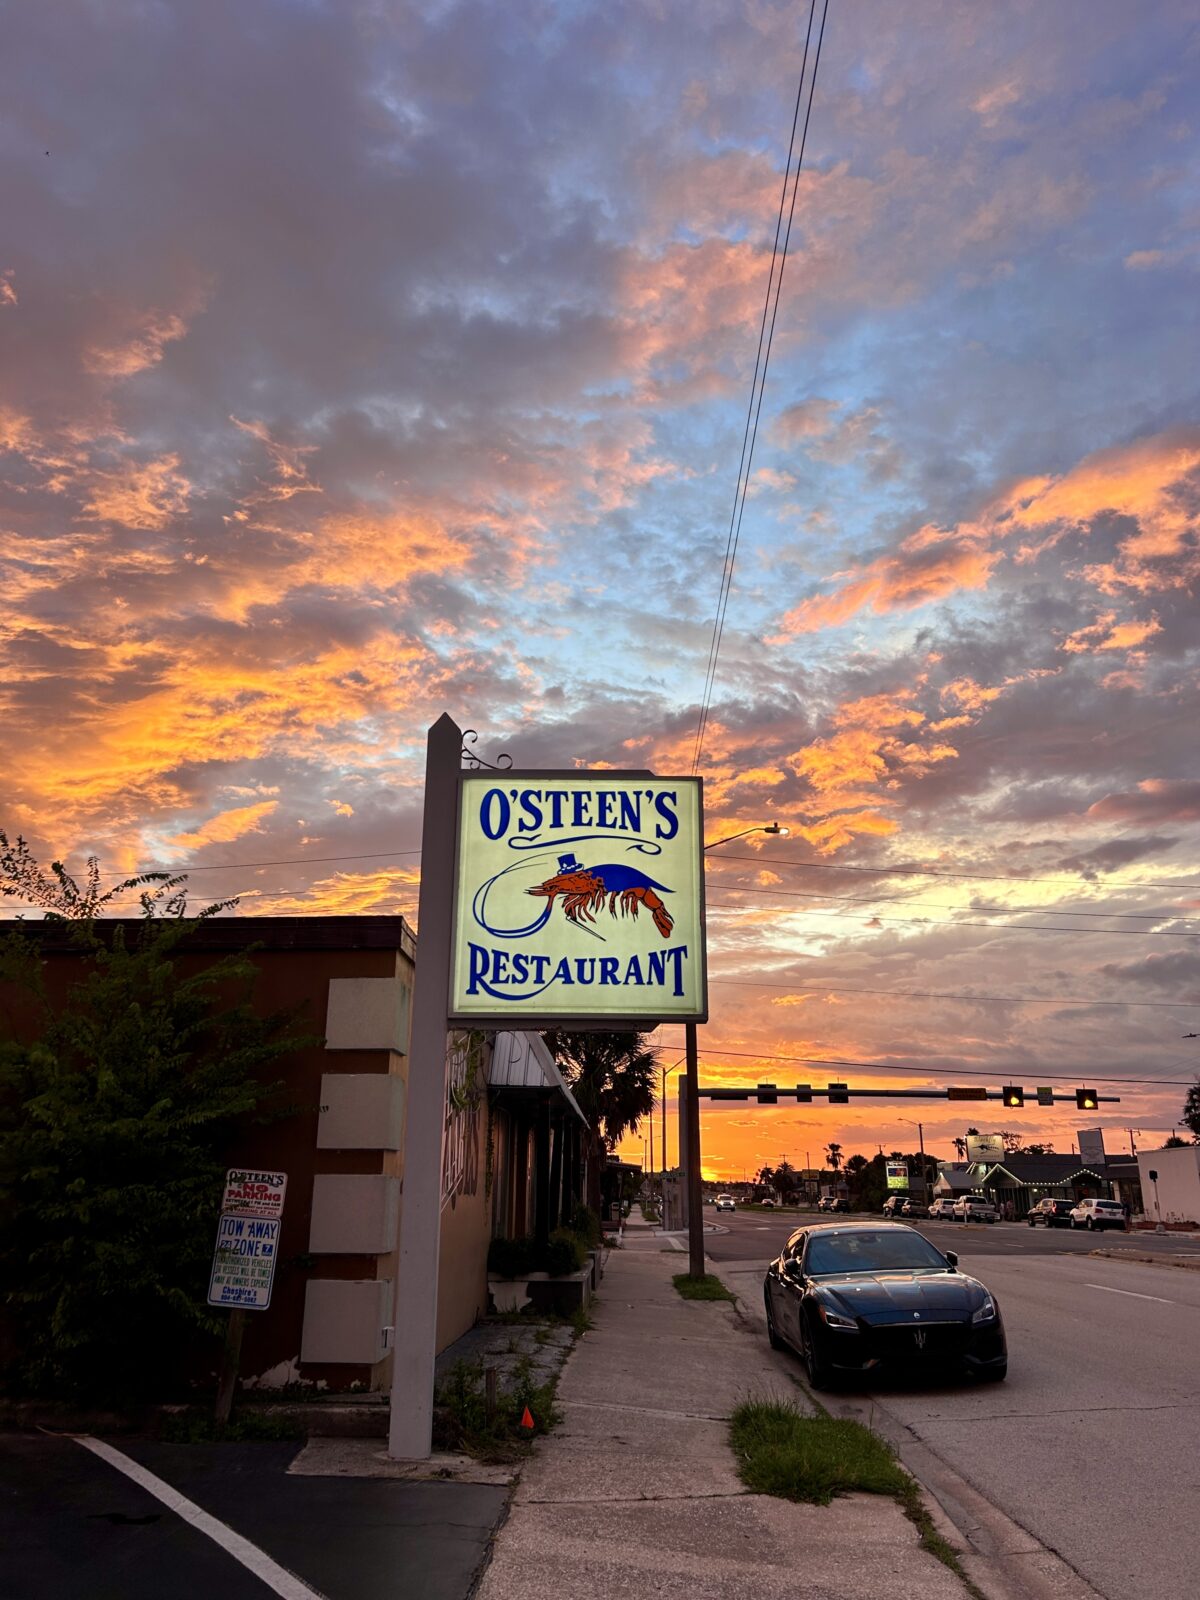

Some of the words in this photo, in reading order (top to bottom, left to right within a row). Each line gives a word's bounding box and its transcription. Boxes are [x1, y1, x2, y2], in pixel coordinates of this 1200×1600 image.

[480, 788, 679, 840] O'STEEN'S
[466, 942, 688, 1001] RESTAURANT
[228, 1189, 281, 1202] PARKING
[243, 1183, 269, 1193] NO
[221, 1219, 245, 1236] TOW
[232, 1239, 261, 1257] ZONE
